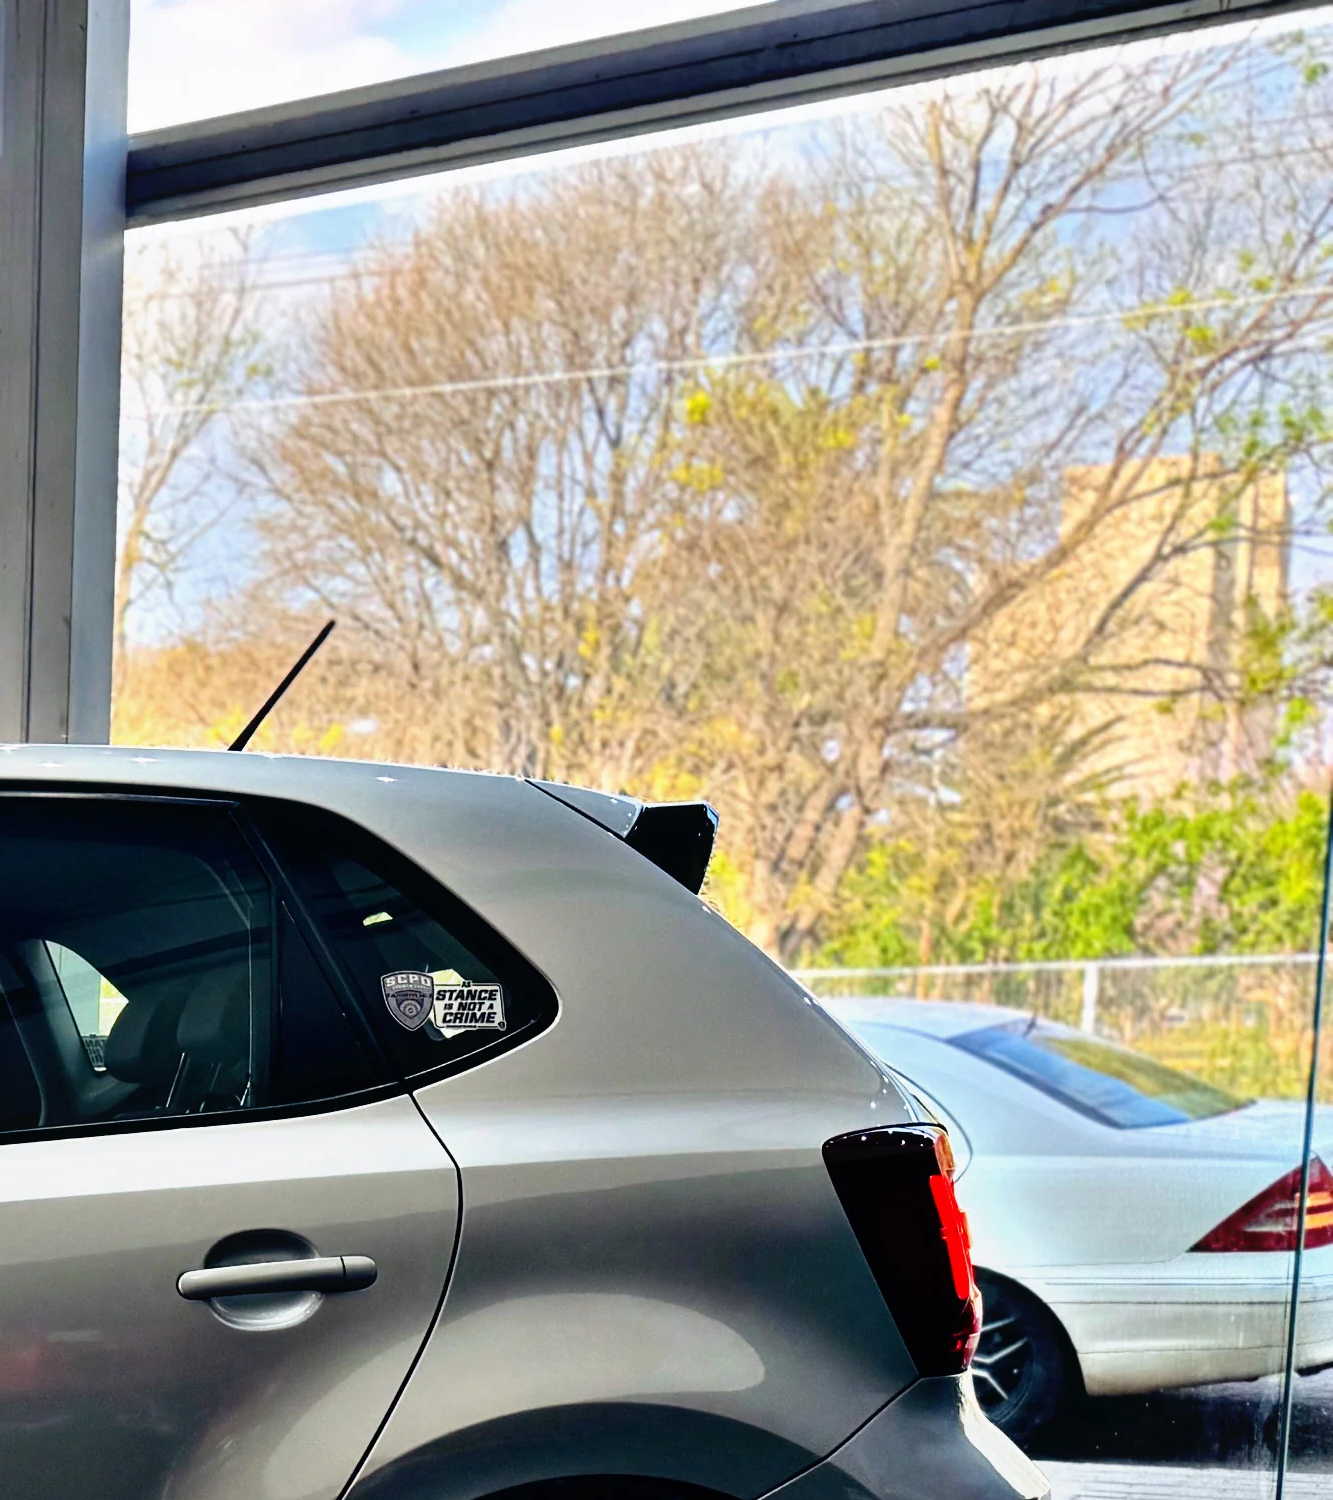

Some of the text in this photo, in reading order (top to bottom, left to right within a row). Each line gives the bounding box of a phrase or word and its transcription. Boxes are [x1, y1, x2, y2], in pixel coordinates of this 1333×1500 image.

[386, 974, 431, 987] SCPD
[435, 989, 498, 1001] STANCE
[457, 1002, 485, 1012] NOT
[442, 1012, 497, 1024] CRIME
